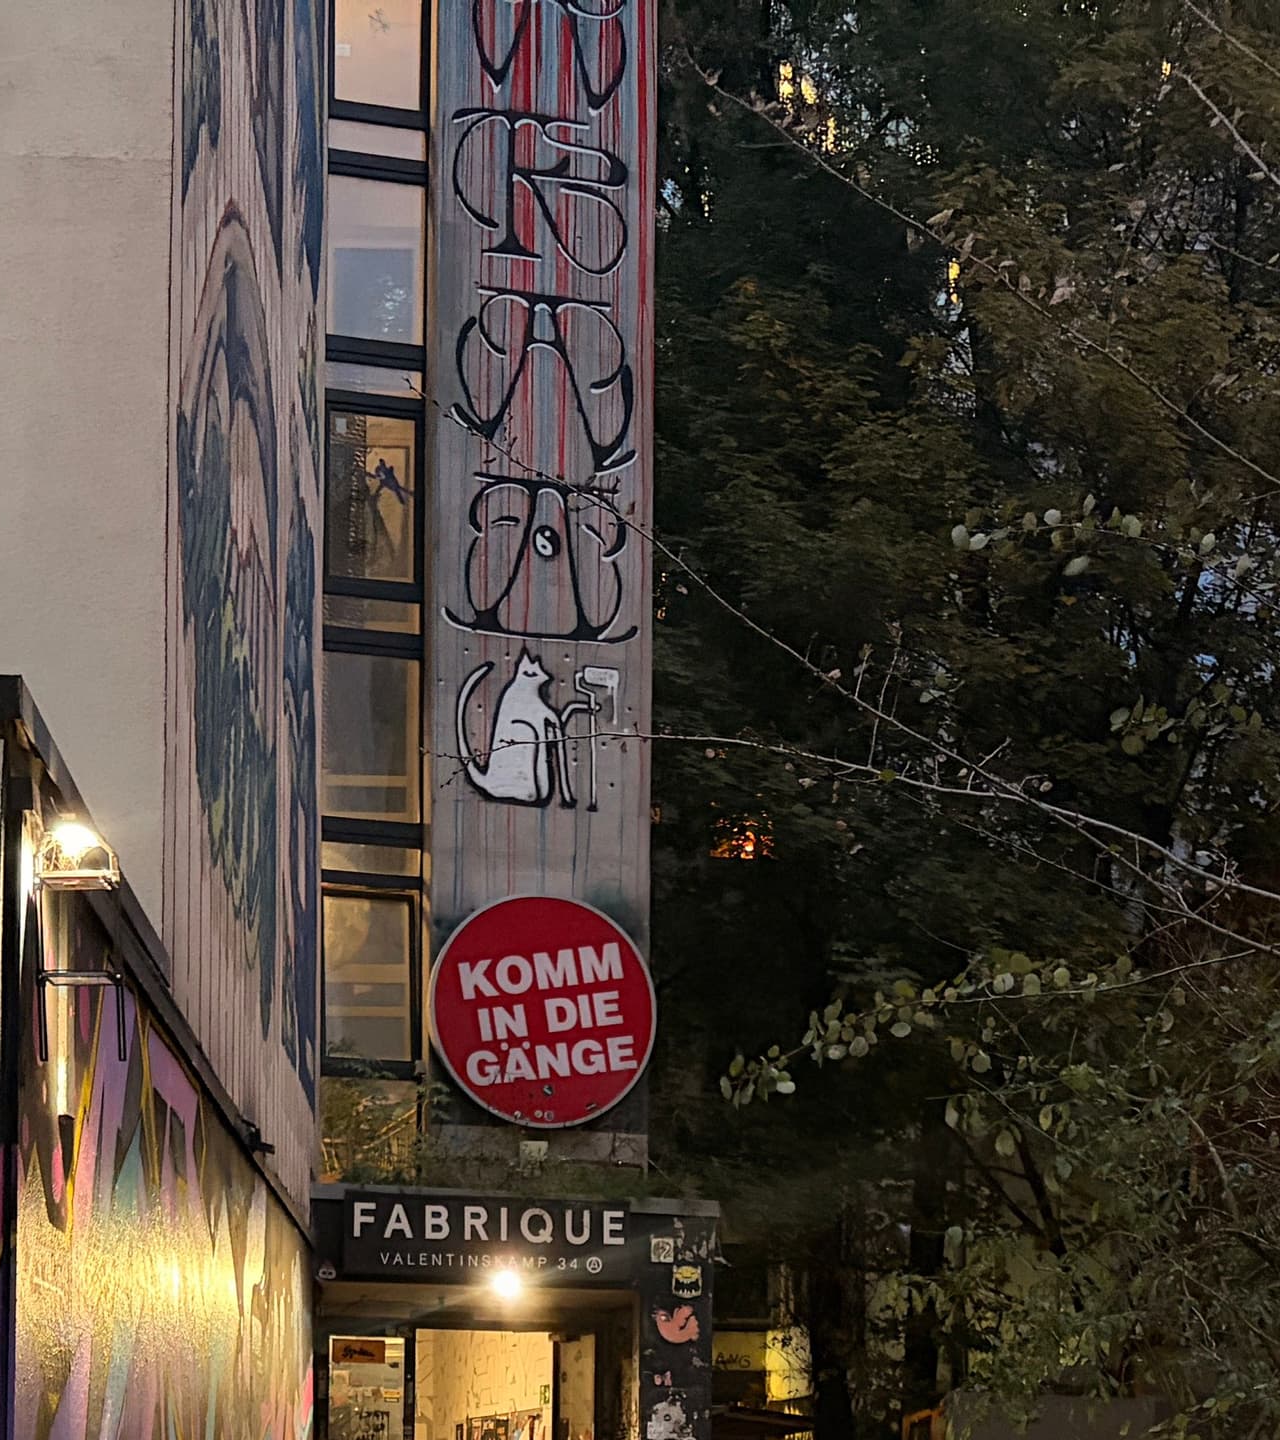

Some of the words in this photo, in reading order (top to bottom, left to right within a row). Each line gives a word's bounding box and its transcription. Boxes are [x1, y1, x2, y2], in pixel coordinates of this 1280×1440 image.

[458, 942, 624, 1000] KOMM
[477, 1004, 529, 1042] IN
[544, 991, 624, 1033] DIE
[466, 1035, 638, 1087] GÄNGE
[352, 1201, 626, 1246] FABRIQUE
[380, 1251, 548, 1270] VALENTINSKAMP
[557, 1256, 579, 1271] 34
